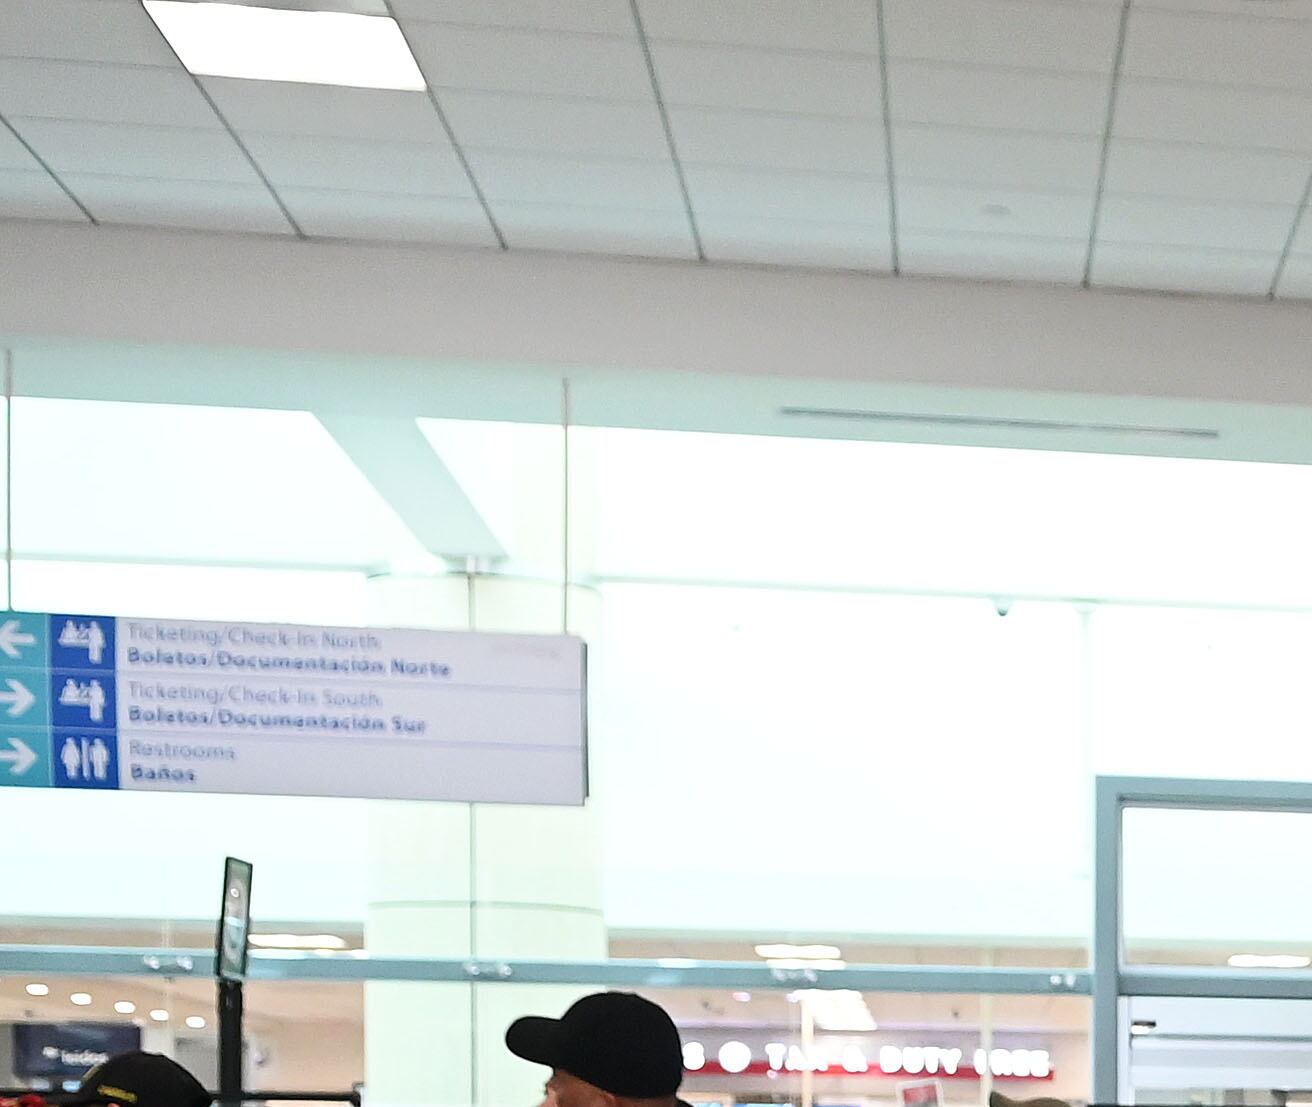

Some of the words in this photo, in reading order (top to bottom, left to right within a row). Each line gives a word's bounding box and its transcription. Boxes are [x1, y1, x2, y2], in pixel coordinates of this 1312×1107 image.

[322, 631, 382, 650] North
[391, 658, 451, 677] Norte
[322, 690, 383, 708] South
[391, 716, 427, 734] Sur
[129, 739, 236, 761] Restrooms
[131, 764, 197, 782] Baños
